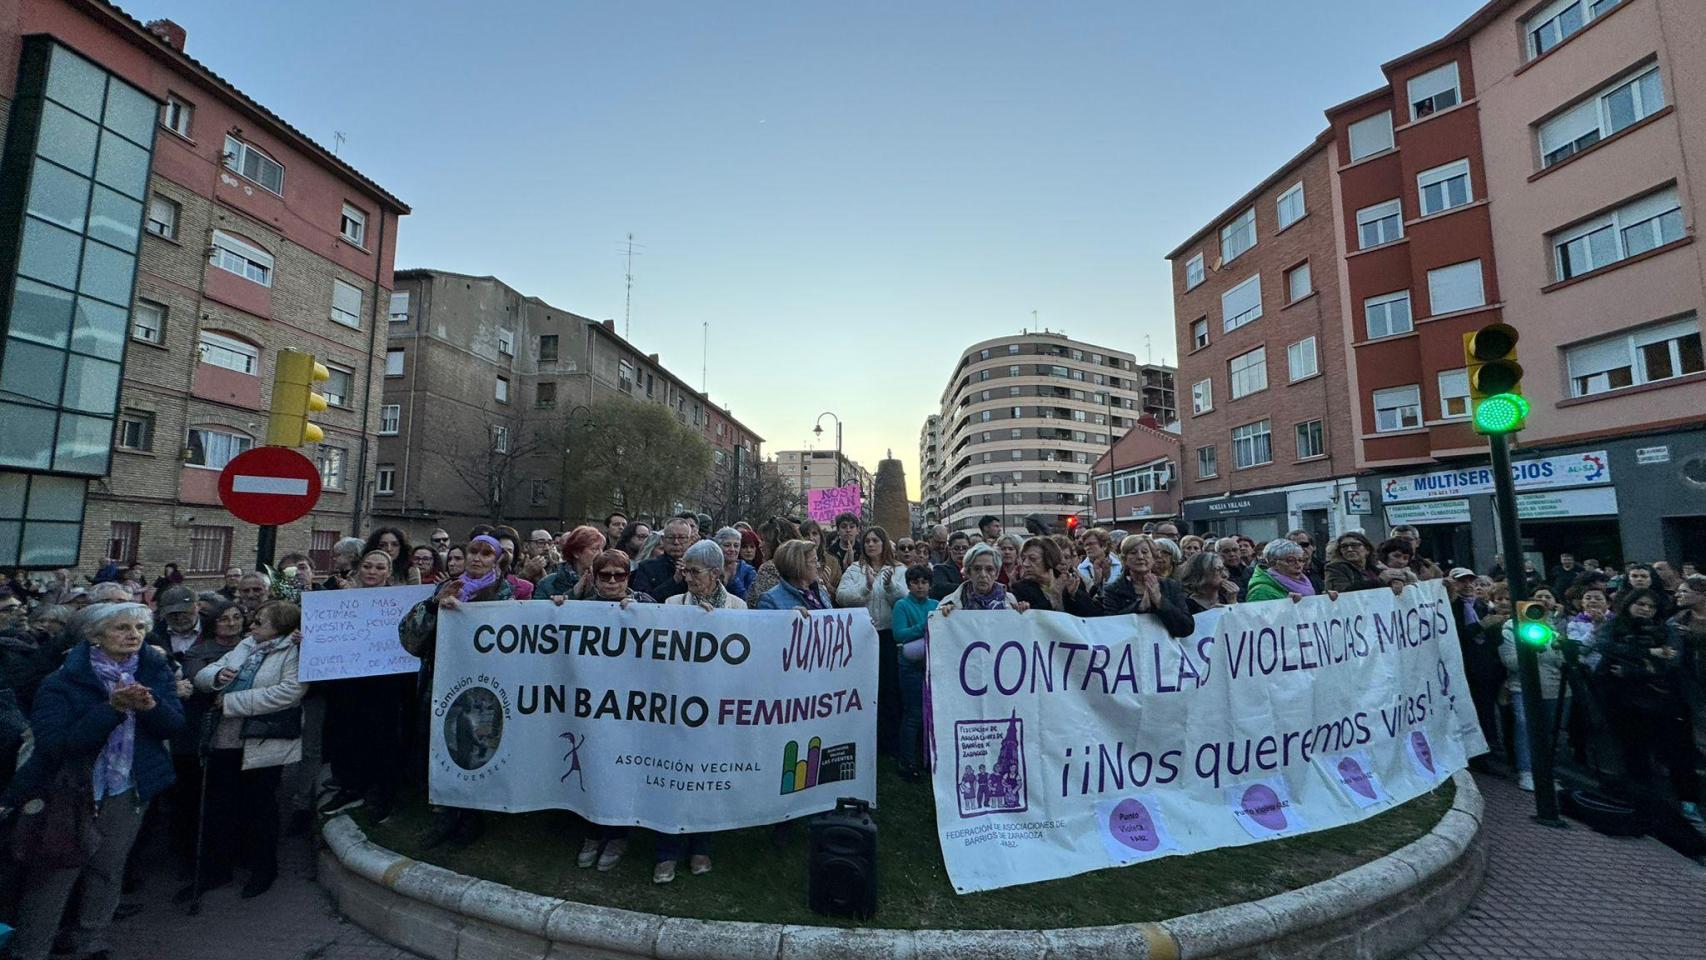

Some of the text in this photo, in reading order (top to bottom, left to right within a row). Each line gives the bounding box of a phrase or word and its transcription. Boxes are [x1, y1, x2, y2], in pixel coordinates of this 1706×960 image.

[1413, 461, 1554, 491] MULTISERCIOS
[821, 488, 848, 500] NOS
[340, 600, 360, 609] NO
[474, 624, 751, 665] CONSTRUYENDO
[959, 640, 1139, 696] CONTRA
[1153, 636, 1215, 693] LAS
[1225, 614, 1369, 679] VIOLENCIAS
[434, 673, 512, 720] Comisión de la mujer
[517, 684, 863, 728] UN BARRIO FEMINISTA
[1195, 712, 1371, 788] queremos
[615, 755, 761, 773] ASOCIACIÓN VECINAL
[646, 775, 731, 791] LAS FUENTES
[1119, 812, 1140, 821] Punto
[1002, 820, 1055, 832] ASOCIACIONES
[965, 831, 998, 847] BARRIOS
[1007, 830, 1043, 840] ZARAGOZA
